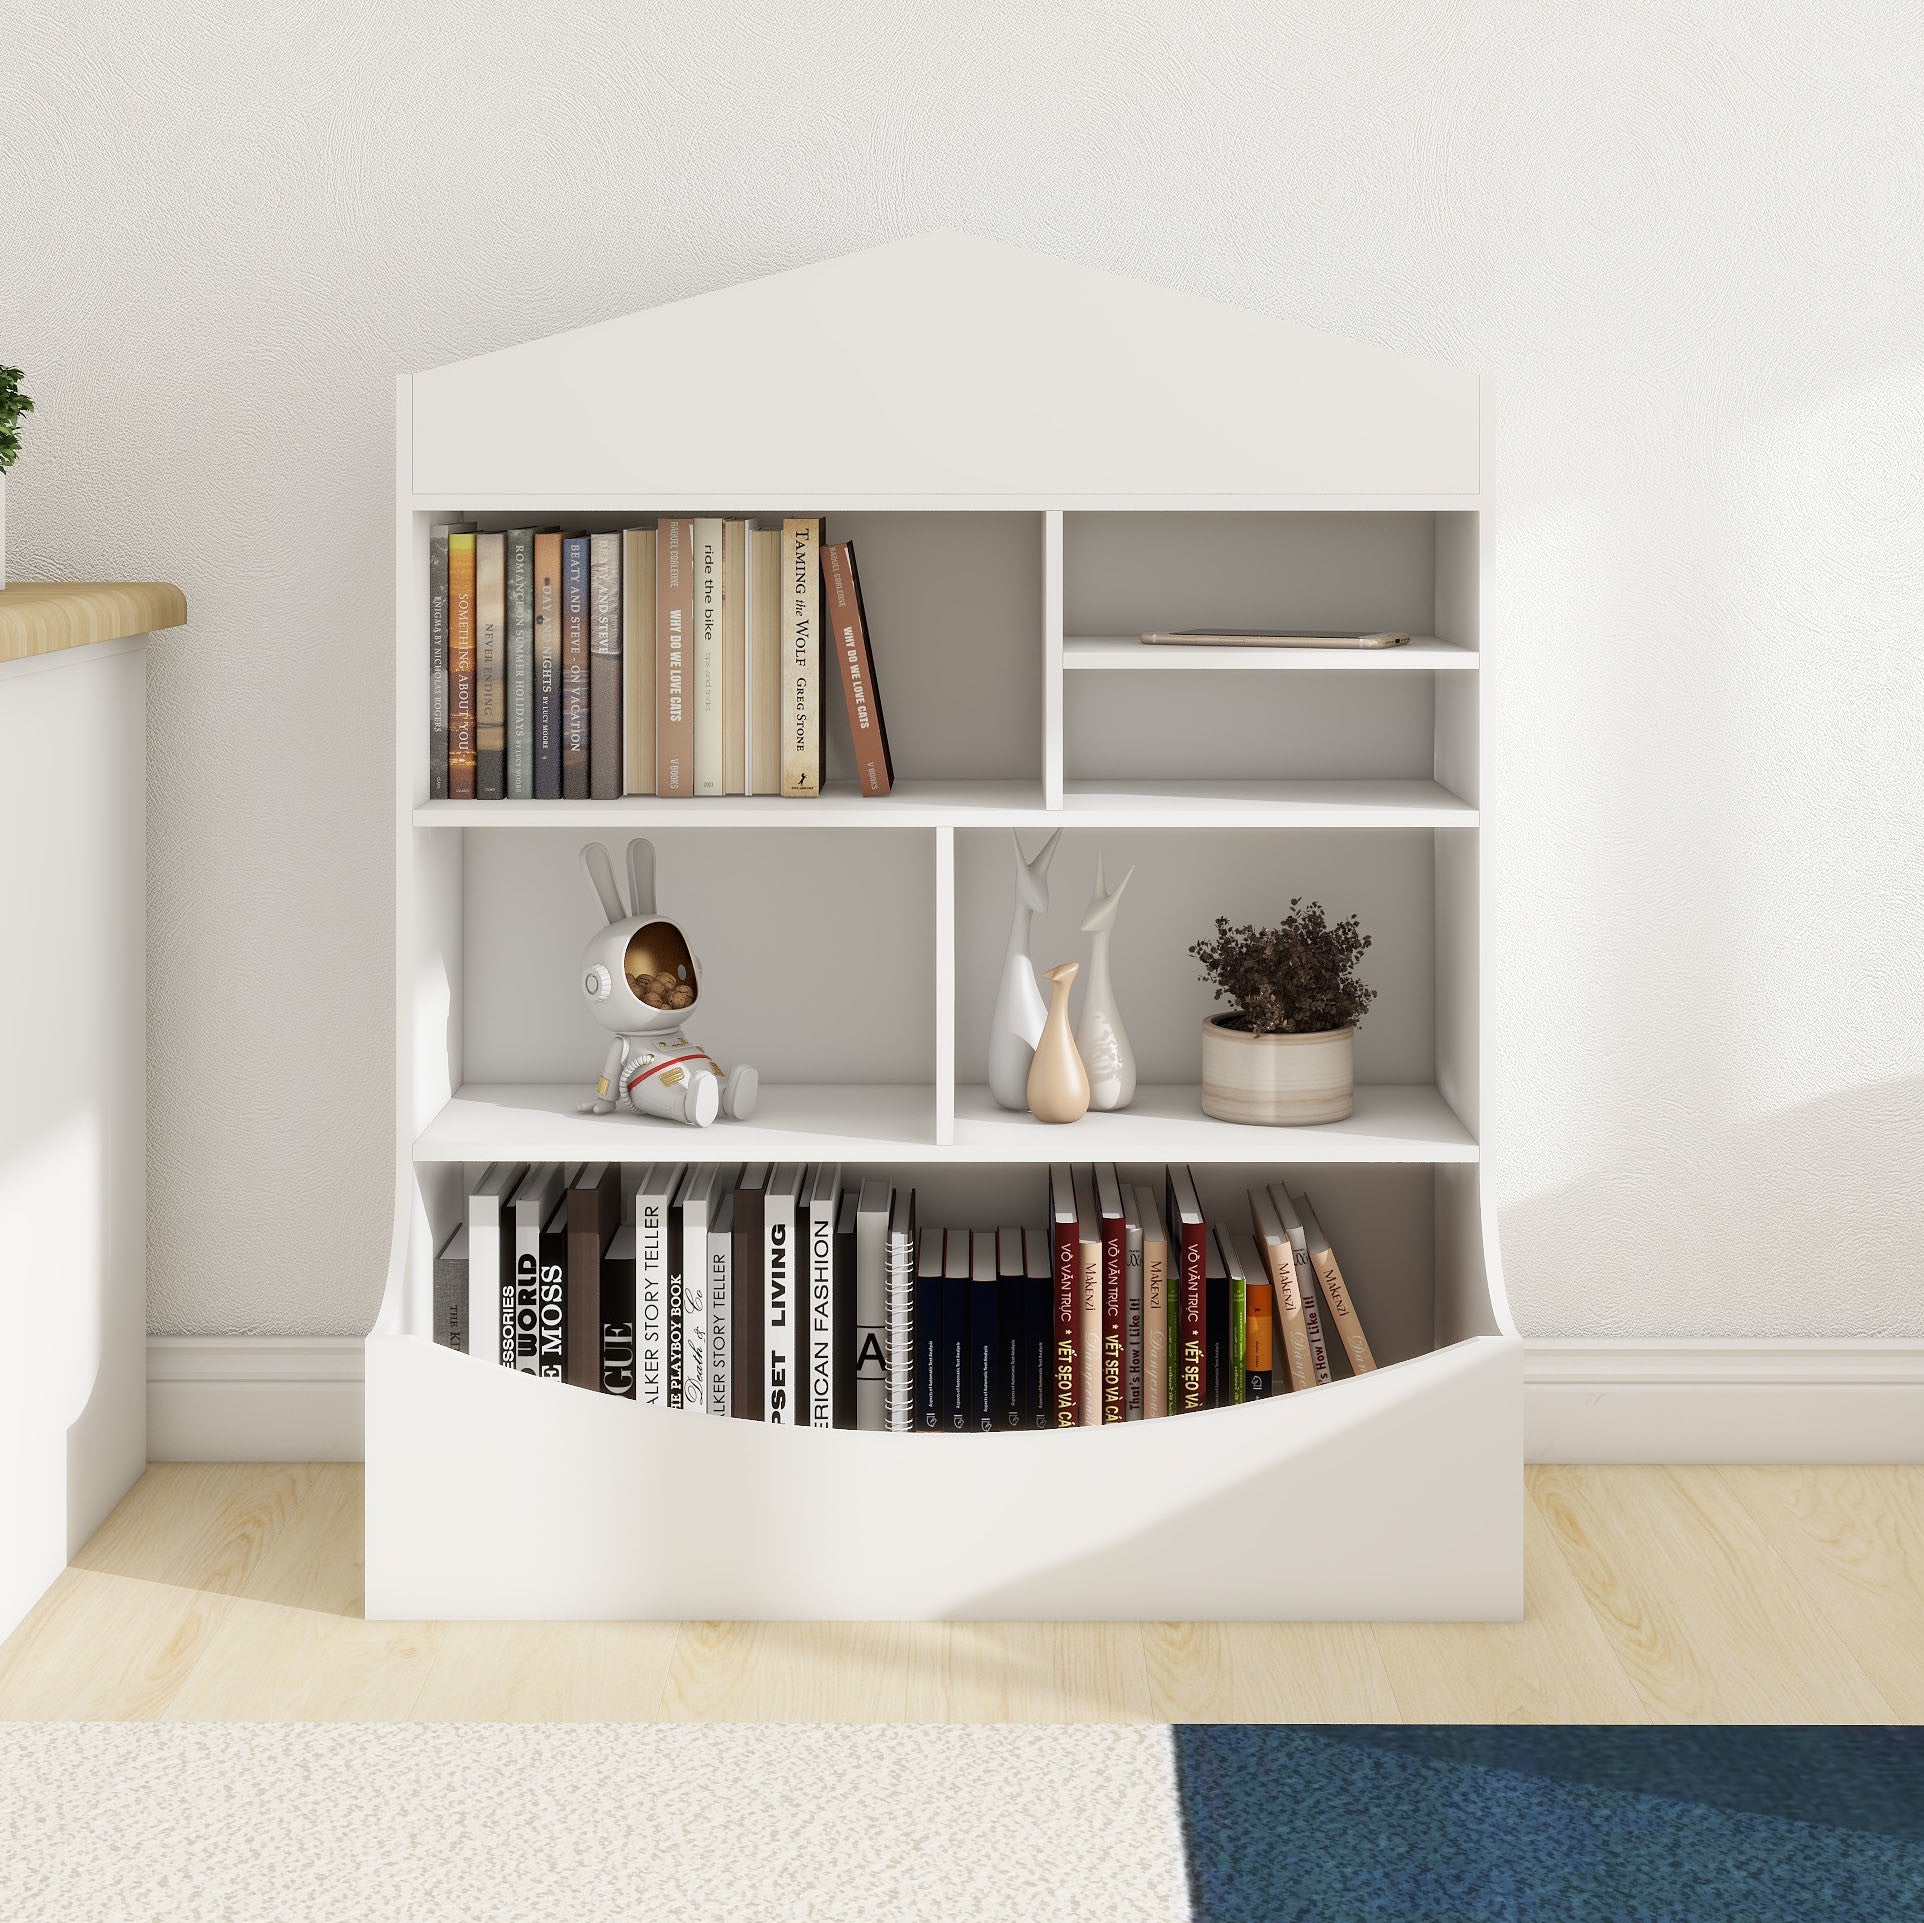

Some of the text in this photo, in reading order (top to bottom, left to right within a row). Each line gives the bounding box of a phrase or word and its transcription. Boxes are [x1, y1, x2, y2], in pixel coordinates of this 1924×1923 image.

[515, 544, 525, 607] ROMANCE
[571, 544, 580, 581] BEATY
[670, 550, 679, 589] CORLEONE
[542, 586, 552, 611] DAY
[571, 586, 580, 613] AND
[599, 540, 609, 654] BEATY AND STEVE
[704, 544, 714, 640] ride the bike
[796, 528, 810, 667] TAMING the WOLF
[515, 608, 525, 626] ON
[571, 616, 580, 654] STEVE
[434, 596, 442, 732] ENIGMA BY NICHOLAS ROGERS
[458, 594, 469, 750] SOMETHING ABOUT YOU
[484, 623, 494, 716] NEVER ENDING
[515, 630, 525, 677] SUMMER
[542, 646, 552, 693] NIGHTS
[670, 609, 682, 722] WHY DO WE LOVE CATS
[570, 665, 580, 683] ON
[843, 626, 869, 729] WHY DO WE LOVE CATS
[515, 681, 525, 737] HOLIDAYS
[542, 696, 549, 705] BY
[797, 677, 807, 752] GREG STONE
[570, 688, 580, 752] VACATION
[645, 1206, 659, 1271] TELLER
[771, 1223, 786, 1327] LIVING
[814, 1220, 829, 1331] FASHION
[1060, 1264, 1074, 1290] VĂN
[1107, 1259, 1120, 1285] VĂN
[1187, 1265, 1201, 1291] VĂN
[518, 1253, 538, 1357] WORLD
[541, 1264, 562, 1355] MOSS
[645, 1277, 659, 1342] STORY
[671, 1273, 682, 1317] BOOK
[684, 1287, 703, 1314] Co
[450, 1331, 461, 1351] KI
[713, 1254, 726, 1417] LKER STORY TELLER
[1129, 1315, 1140, 1337] Like
[1308, 1312, 1319, 1335] Like
[603, 1322, 634, 1394] GUE
[671, 1319, 682, 1390] PLAYBOY
[856, 1333, 887, 1371] A
[1058, 1340, 1077, 1363] VẾT
[1105, 1334, 1124, 1358] VẾT
[1129, 1349, 1140, 1373] How
[1185, 1340, 1204, 1364] VẾT
[1316, 1346, 1326, 1371] How
[684, 1339, 703, 1405] Death
[1054, 1365, 1072, 1390] SẸO
[1182, 1365, 1199, 1391] SẸO
[1058, 1392, 1076, 1408] VÀ
[1105, 1386, 1123, 1403] VÀ
[1129, 1377, 1140, 1410] That's
[1185, 1393, 1203, 1409] VÀ
